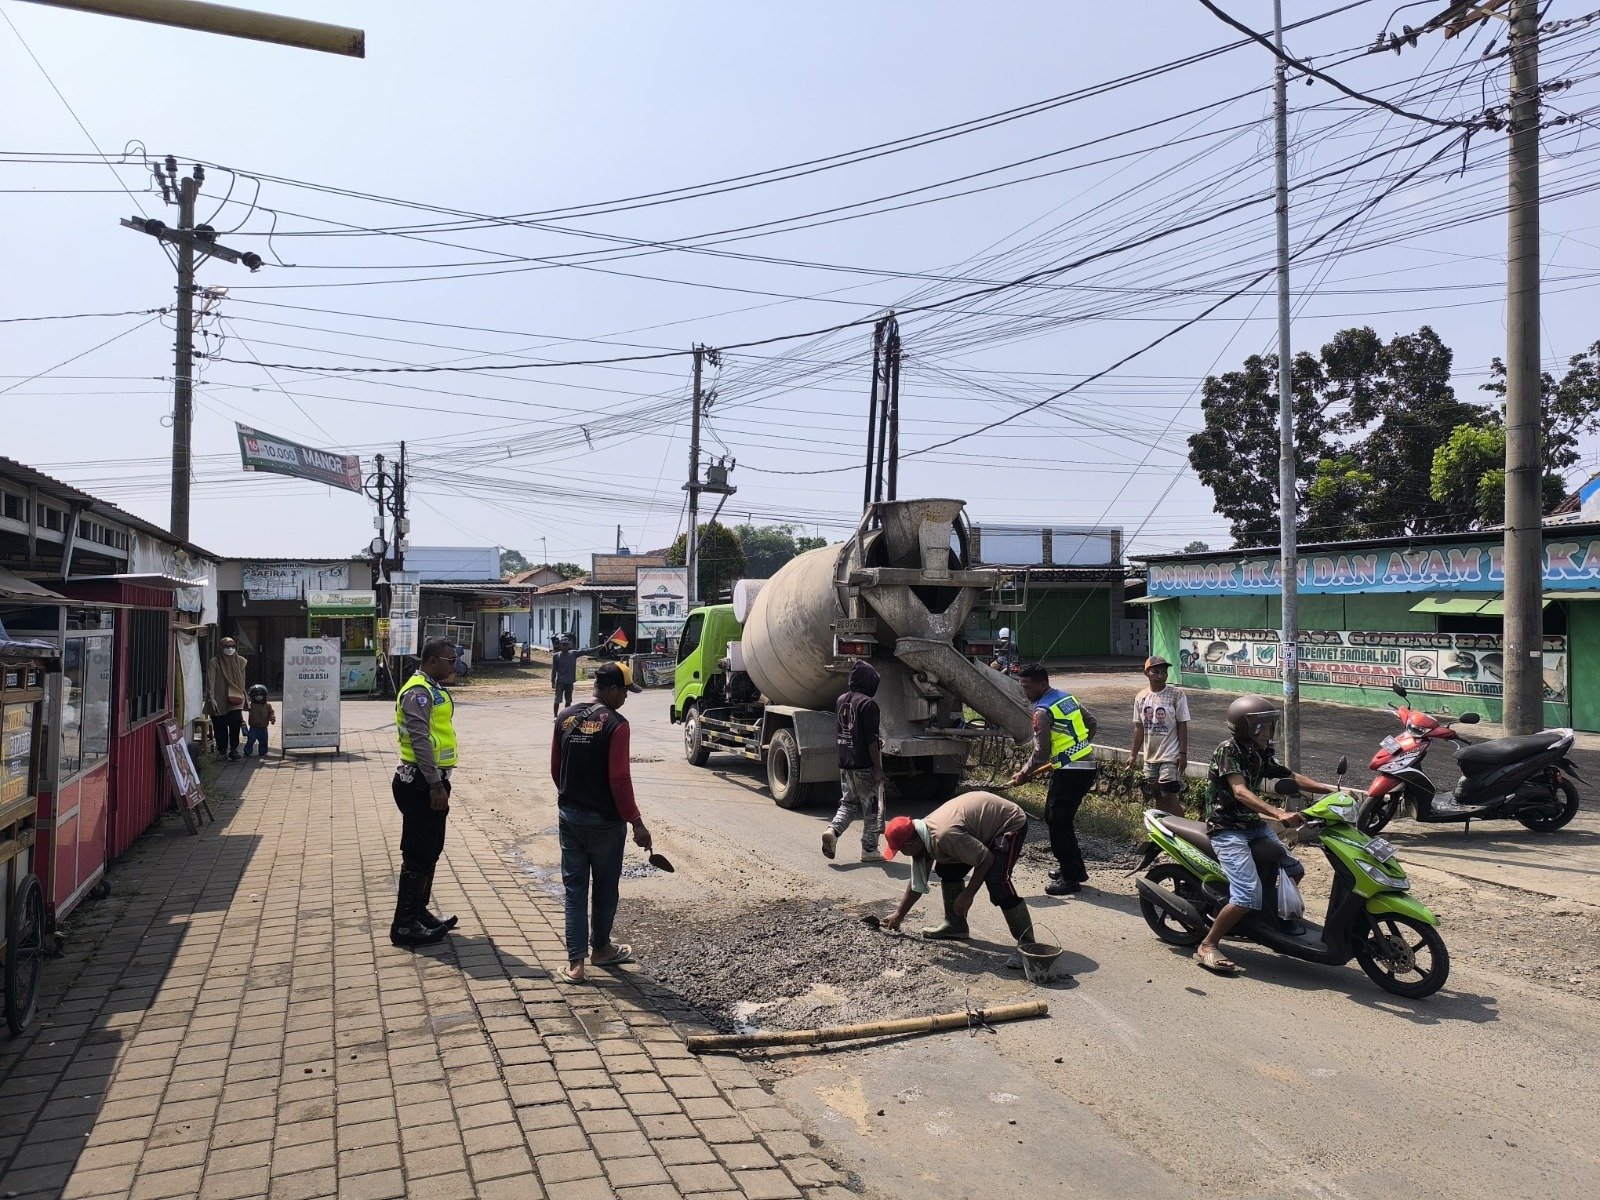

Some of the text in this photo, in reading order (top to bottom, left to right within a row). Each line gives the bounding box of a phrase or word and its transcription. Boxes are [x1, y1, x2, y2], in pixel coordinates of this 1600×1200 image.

[264, 445, 295, 460] 10.000
[301, 448, 343, 474] MANOR
[1149, 563, 1238, 590] PONDOK
[1312, 554, 1377, 587] DAN
[1382, 548, 1482, 584] AYAM
[1180, 627, 1215, 640] SAE
[1217, 628, 1280, 642] TENDA
[1296, 631, 1344, 646] ASA
[1347, 632, 1453, 649] GORENG
[287, 656, 337, 666] JUMBO
[1305, 647, 1339, 660] PENYET
[1340, 649, 1379, 662] SAMBAL
[1380, 651, 1397, 663] IJO
[1208, 664, 1235, 674] LALAPAN
[1398, 678, 1420, 688] SOTO
[1426, 680, 1461, 691] TERONG
